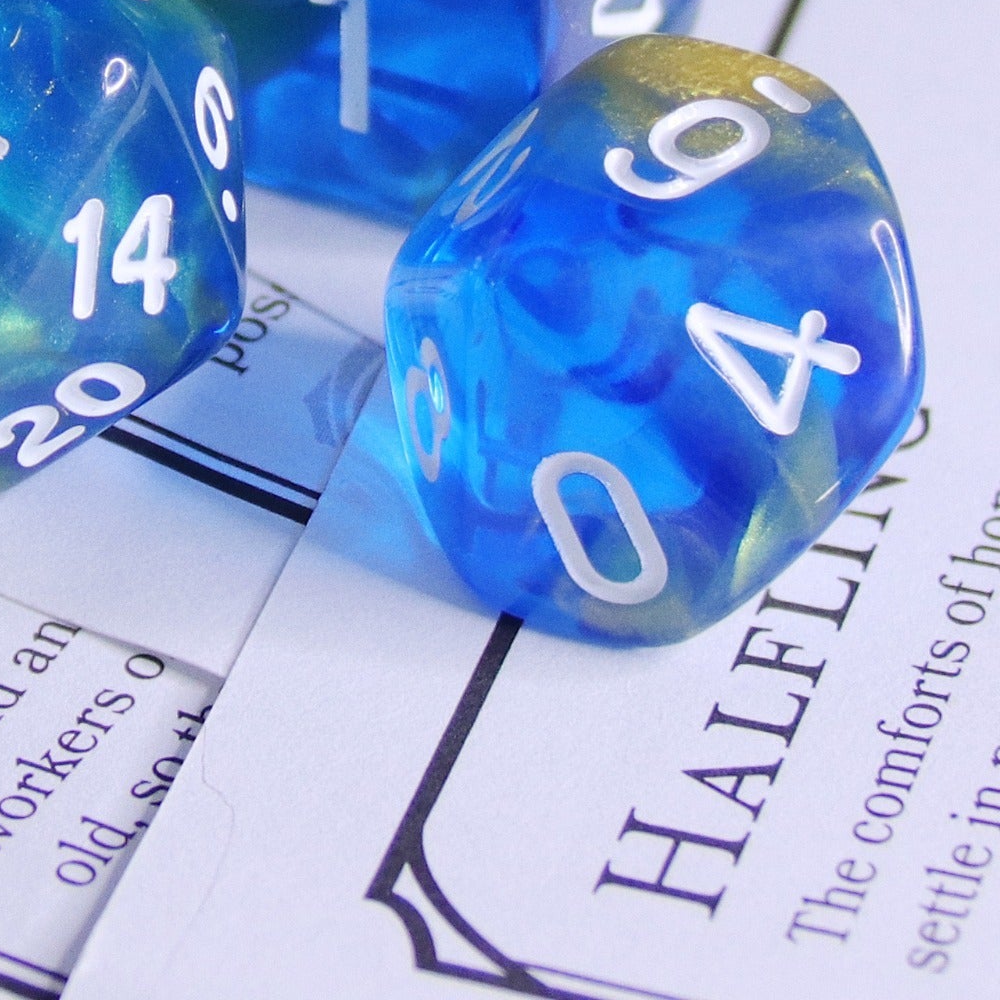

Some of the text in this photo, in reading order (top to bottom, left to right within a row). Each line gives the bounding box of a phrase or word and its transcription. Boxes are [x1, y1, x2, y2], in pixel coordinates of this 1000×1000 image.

[62, 193, 178, 320] 14
[685, 301, 861, 436] 4
[531, 450, 669, 605] 0
[785, 858, 878, 945] The
[852, 637, 974, 846] comforts
[938, 573, 995, 627] of
[55, 815, 150, 887] old,
[906, 842, 994, 974] settle
